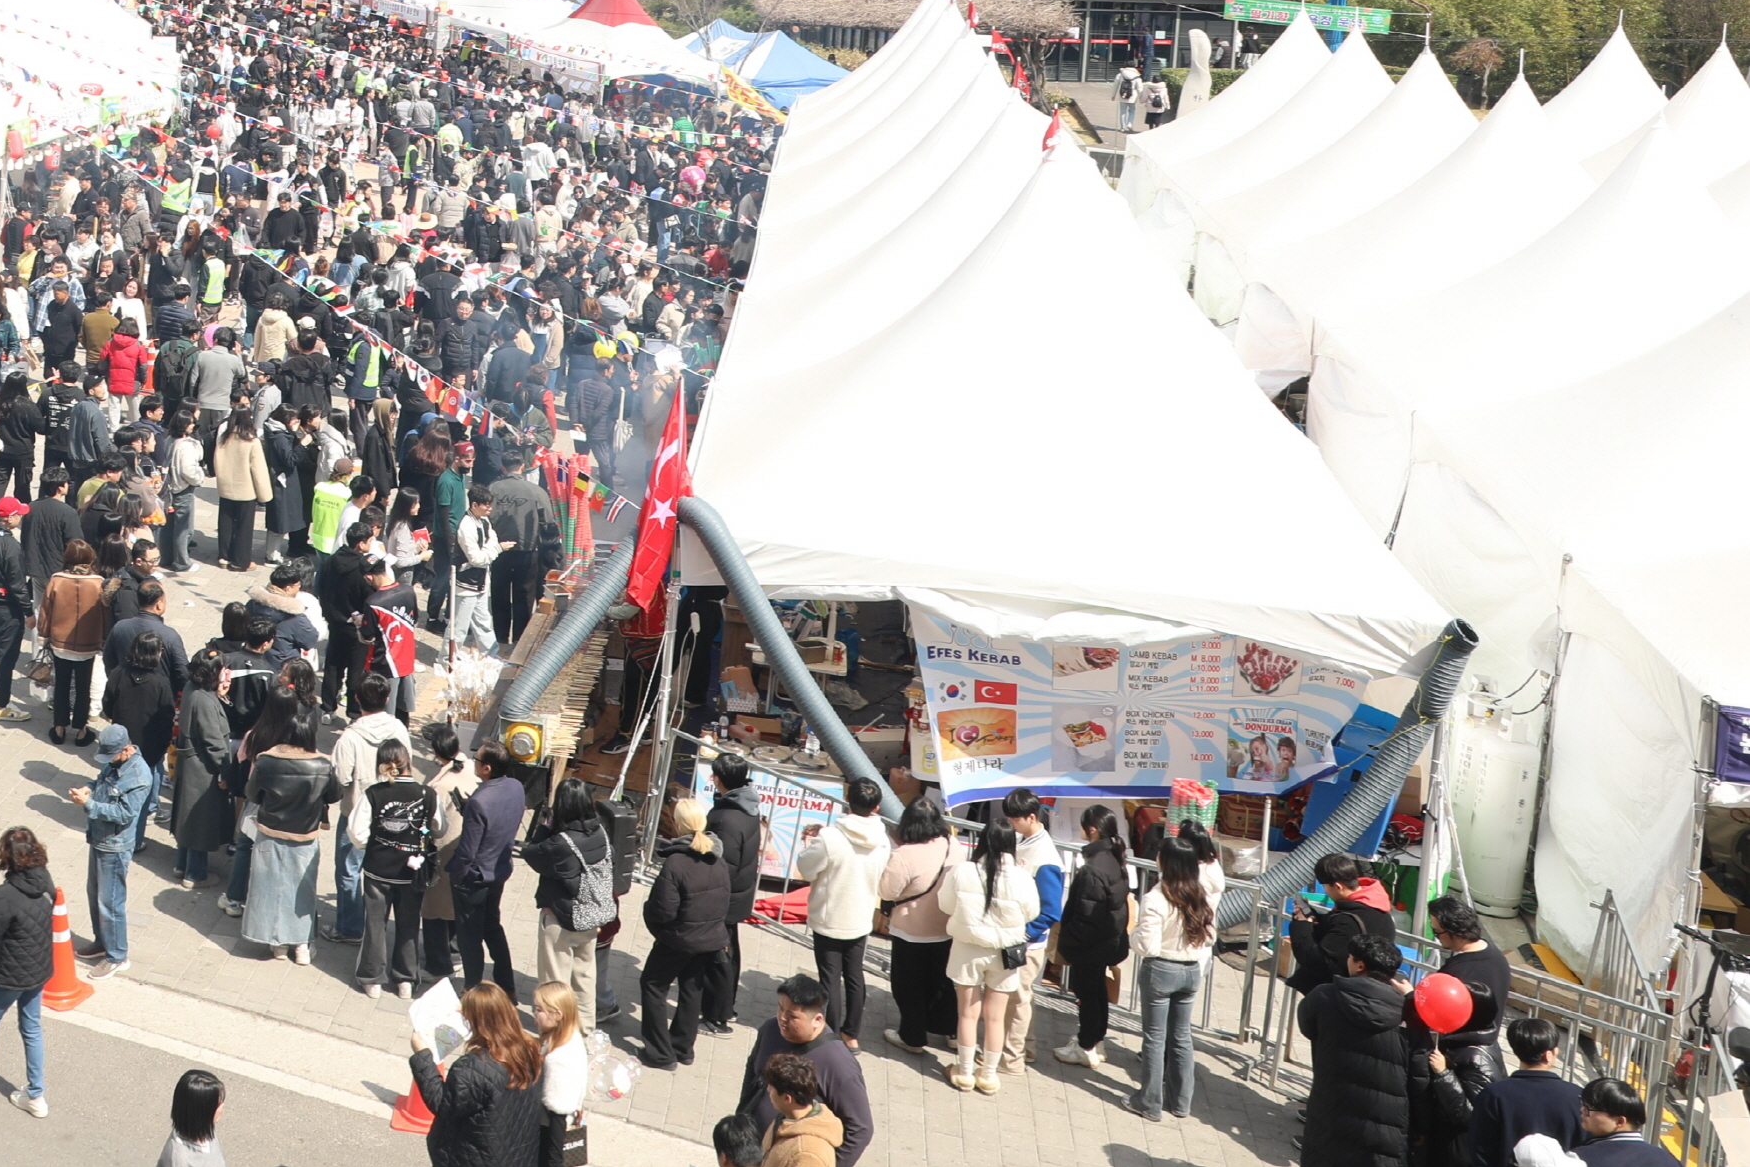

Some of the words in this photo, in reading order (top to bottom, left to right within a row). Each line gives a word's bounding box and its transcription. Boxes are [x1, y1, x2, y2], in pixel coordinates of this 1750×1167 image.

[1191, 641, 1196, 649] L
[1201, 641, 1221, 650] 9,000
[927, 645, 963, 660] EFES
[968, 649, 1022, 666] KEBAB
[1128, 650, 1150, 660] LAMB
[1152, 651, 1178, 661] KEBAB
[1191, 654, 1197, 662] M
[1201, 654, 1221, 663] 8,000
[1129, 660, 1146, 668] 양고기
[1197, 664, 1221, 673] 10,000
[1128, 674, 1141, 682] MIX
[1143, 675, 1169, 683] KEBAB
[1336, 677, 1355, 689] 7,000
[1125, 710, 1140, 718] BOX
[1142, 710, 1175, 719] CHICKEN
[1245, 723, 1293, 734] DONDURMA
[975, 733, 1015, 745] Turkey
[1190, 731, 1214, 739] 13,000
[1305, 728, 1325, 742] TURKIYE
[1123, 751, 1139, 760] BOX
[1140, 752, 1153, 760] MIX
[1190, 753, 1213, 762] 14,000
[953, 757, 1004, 775] 형제나라
[785, 787, 800, 796] ICE
